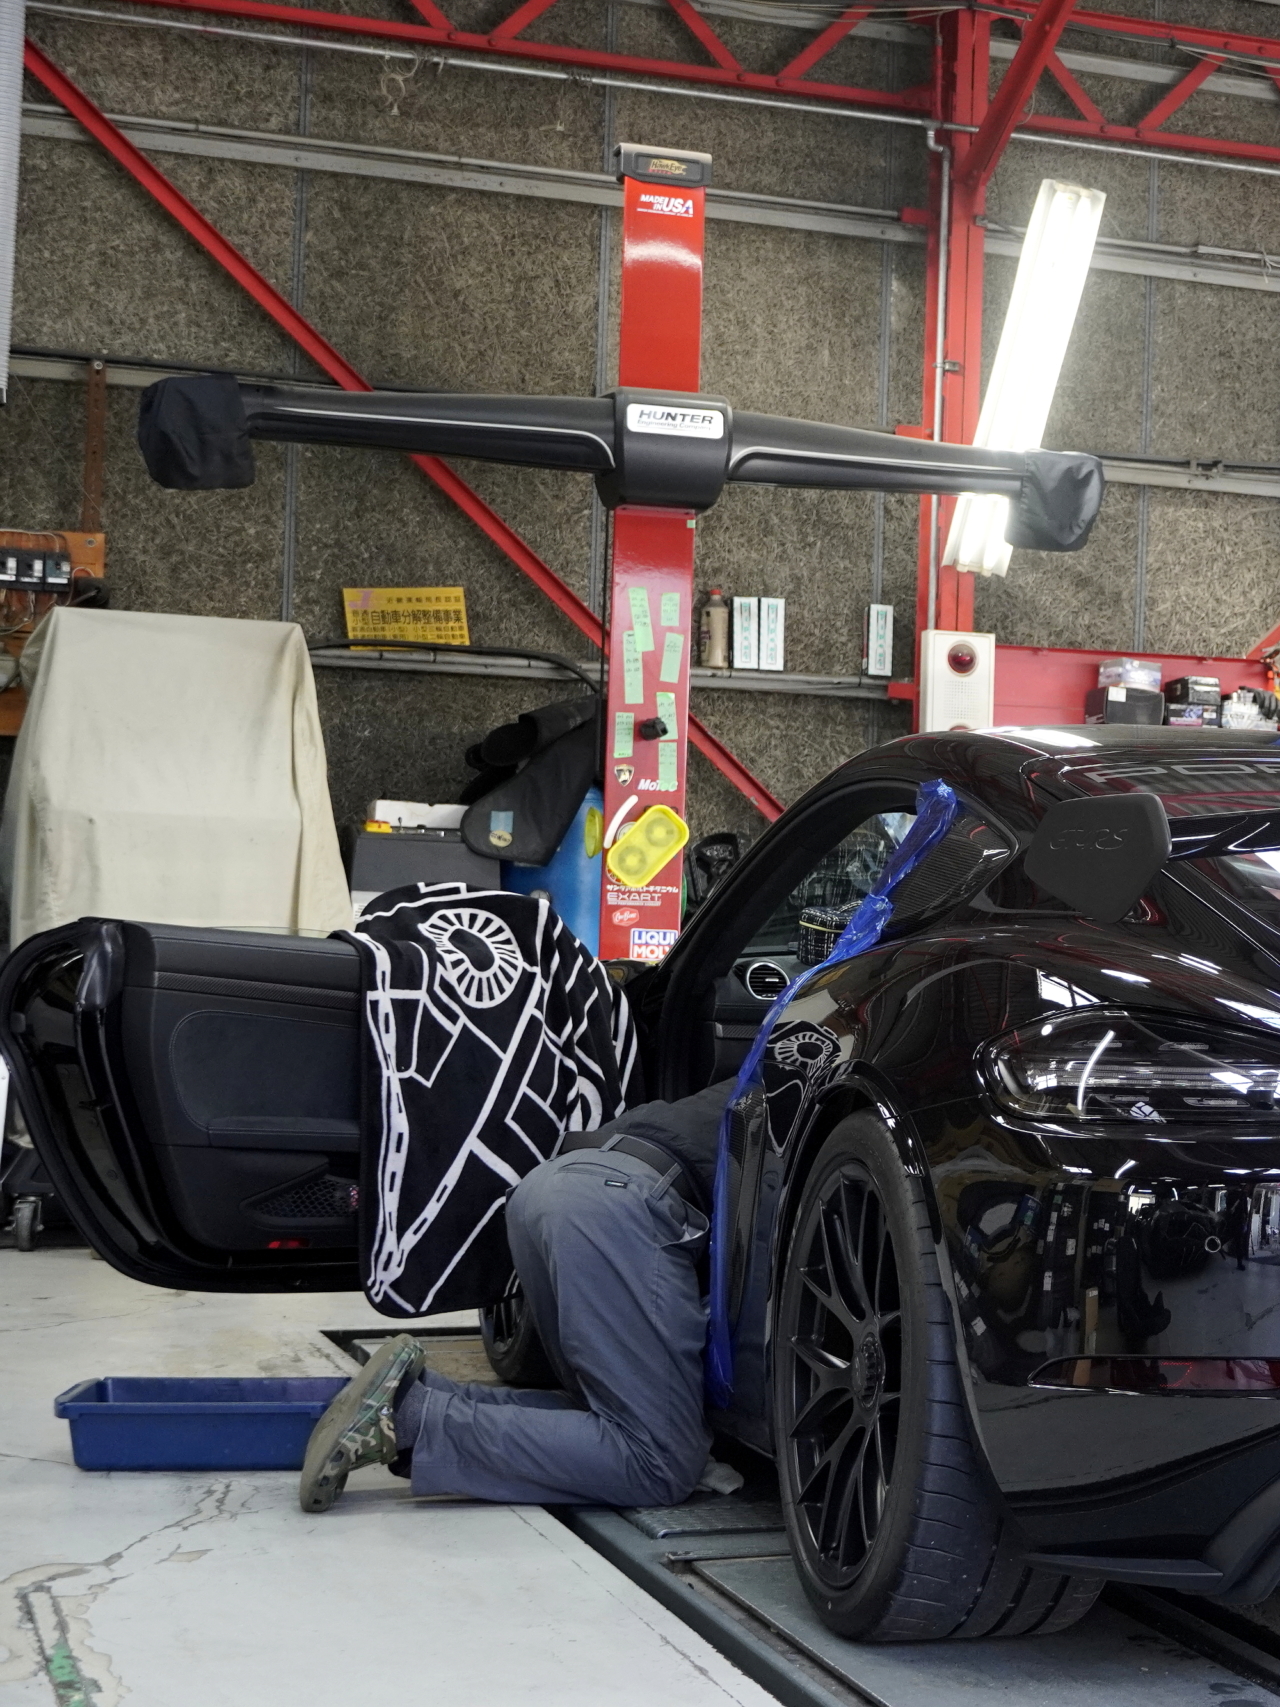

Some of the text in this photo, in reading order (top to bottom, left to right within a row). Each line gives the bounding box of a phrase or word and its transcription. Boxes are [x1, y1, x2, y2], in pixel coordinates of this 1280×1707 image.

[640, 194, 664, 204] MADE
[653, 203, 663, 211] IN
[662, 197, 694, 214] USA
[638, 410, 714, 425] HUNTER
[606, 891, 662, 901] EXART
[633, 930, 675, 945] LIQUI
